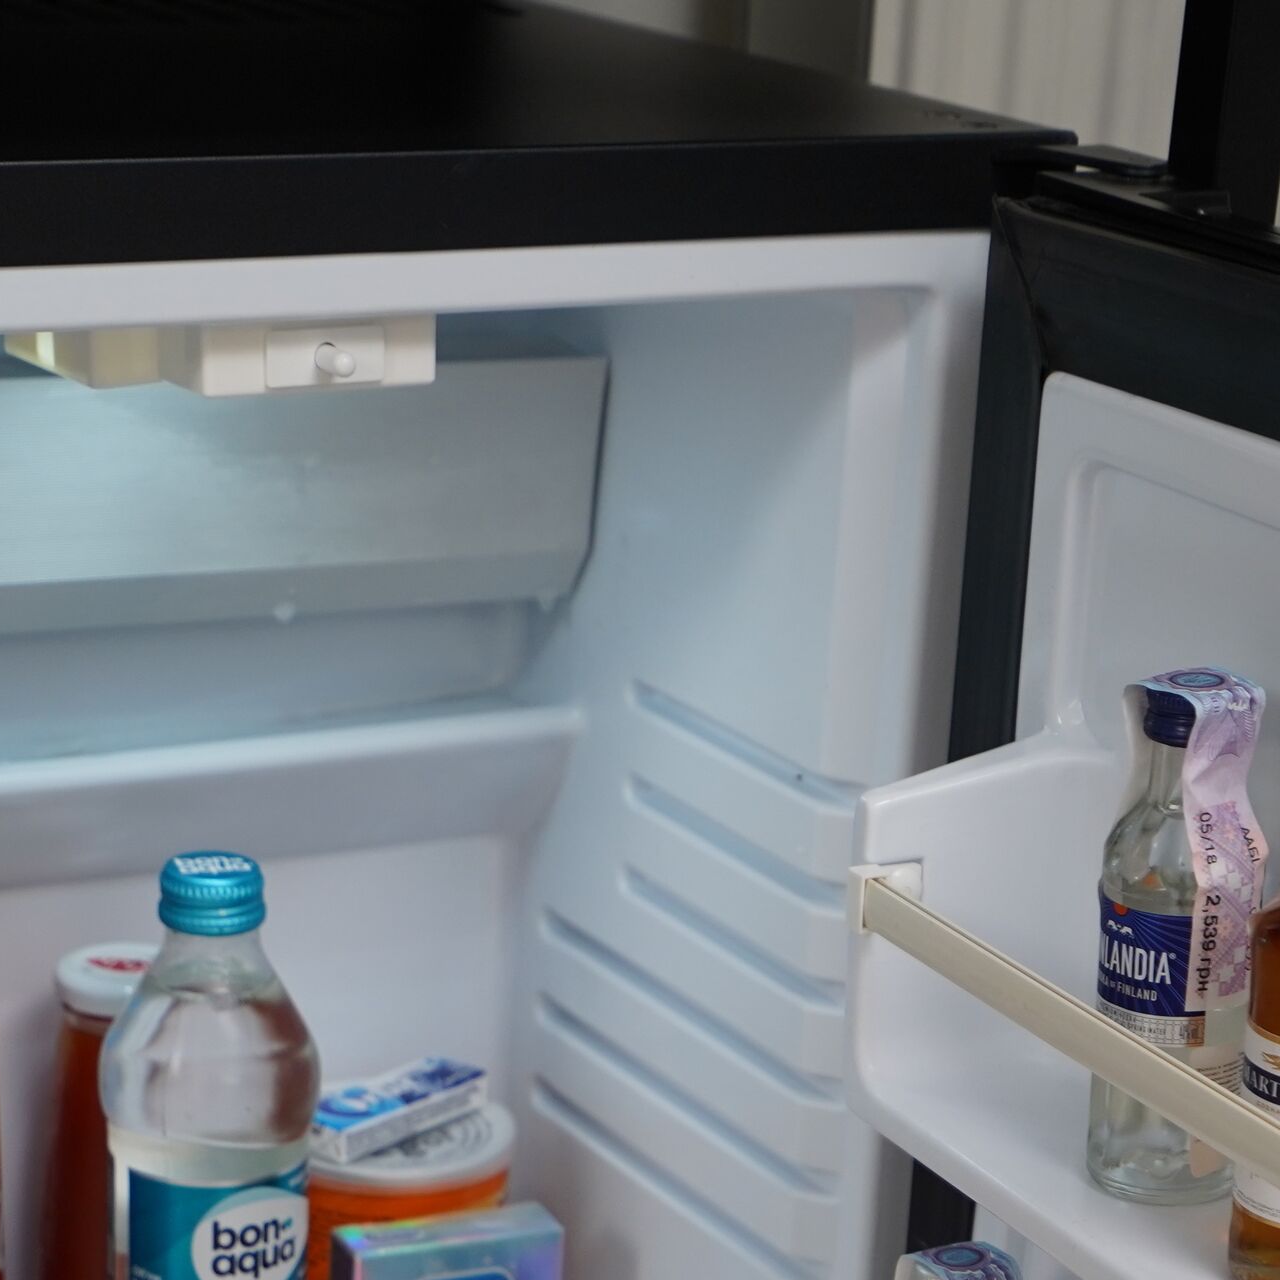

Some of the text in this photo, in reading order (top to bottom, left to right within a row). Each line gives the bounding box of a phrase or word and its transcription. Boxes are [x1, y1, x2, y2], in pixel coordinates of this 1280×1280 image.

[1199, 811, 1217, 864] 05/18
[1195, 894, 1221, 992] 2,539 грн
[1116, 981, 1158, 1002] FINLAND
[211, 1238, 295, 1280] aqua
